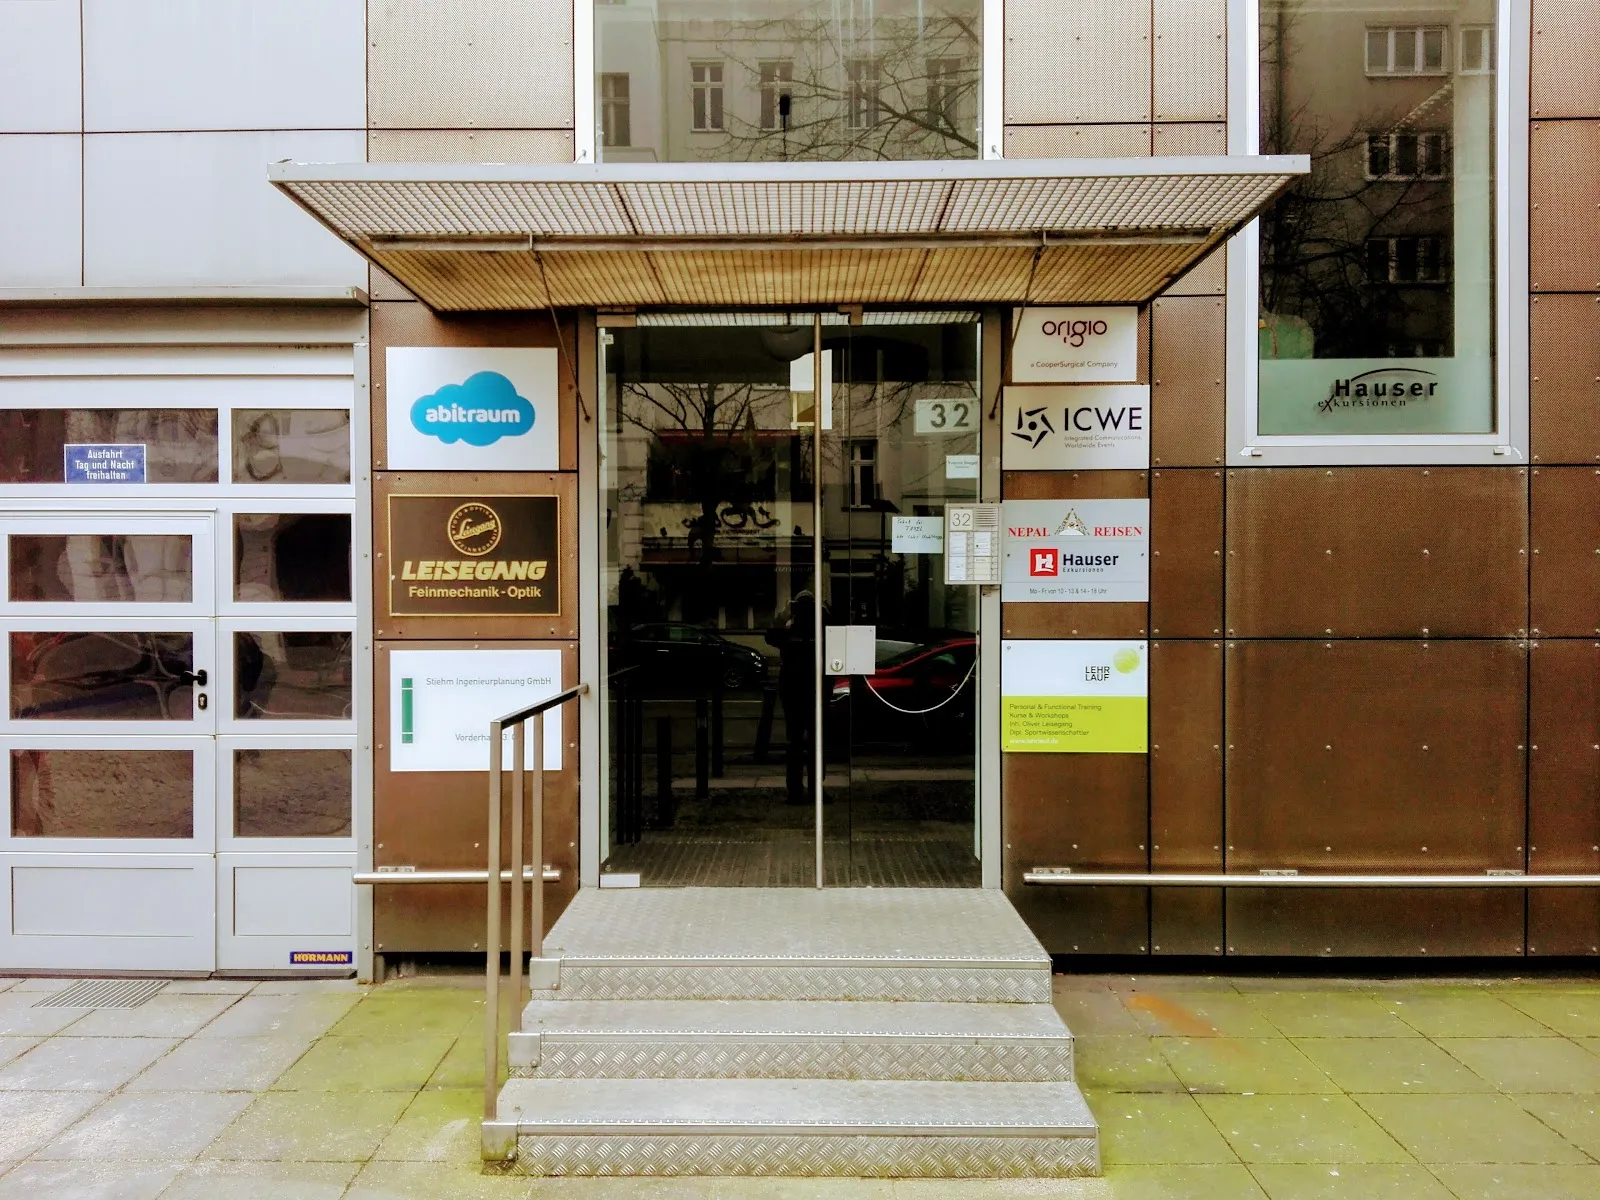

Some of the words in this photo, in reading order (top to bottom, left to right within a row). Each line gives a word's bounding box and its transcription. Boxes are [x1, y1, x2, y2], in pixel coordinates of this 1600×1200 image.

[1042, 320, 1107, 347] origio
[1036, 361, 1085, 369] CooperSurgical
[1086, 361, 1118, 369] Company
[1335, 379, 1438, 397] Hauser
[425, 403, 520, 423] abitraum
[930, 403, 969, 428] 32
[1064, 407, 1142, 431] ICWE
[87, 449, 123, 459] Ausfahrt
[75, 460, 89, 471] Tag
[92, 460, 107, 469] und
[110, 460, 135, 469] Nacht
[86, 470, 126, 480] freihalten
[952, 513, 971, 527] 32
[453, 518, 496, 540] Leisegang
[1007, 527, 1050, 537] NEPAL
[1094, 526, 1143, 537] REISEN
[1063, 553, 1119, 566] Hauser
[1085, 666, 1111, 674] LEHR
[426, 677, 454, 686] Stiehm
[456, 677, 525, 687] Ingenieurplanung
[527, 677, 552, 686] GmbH
[1085, 673, 1110, 682] LAUF
[1078, 703, 1102, 711] Training
